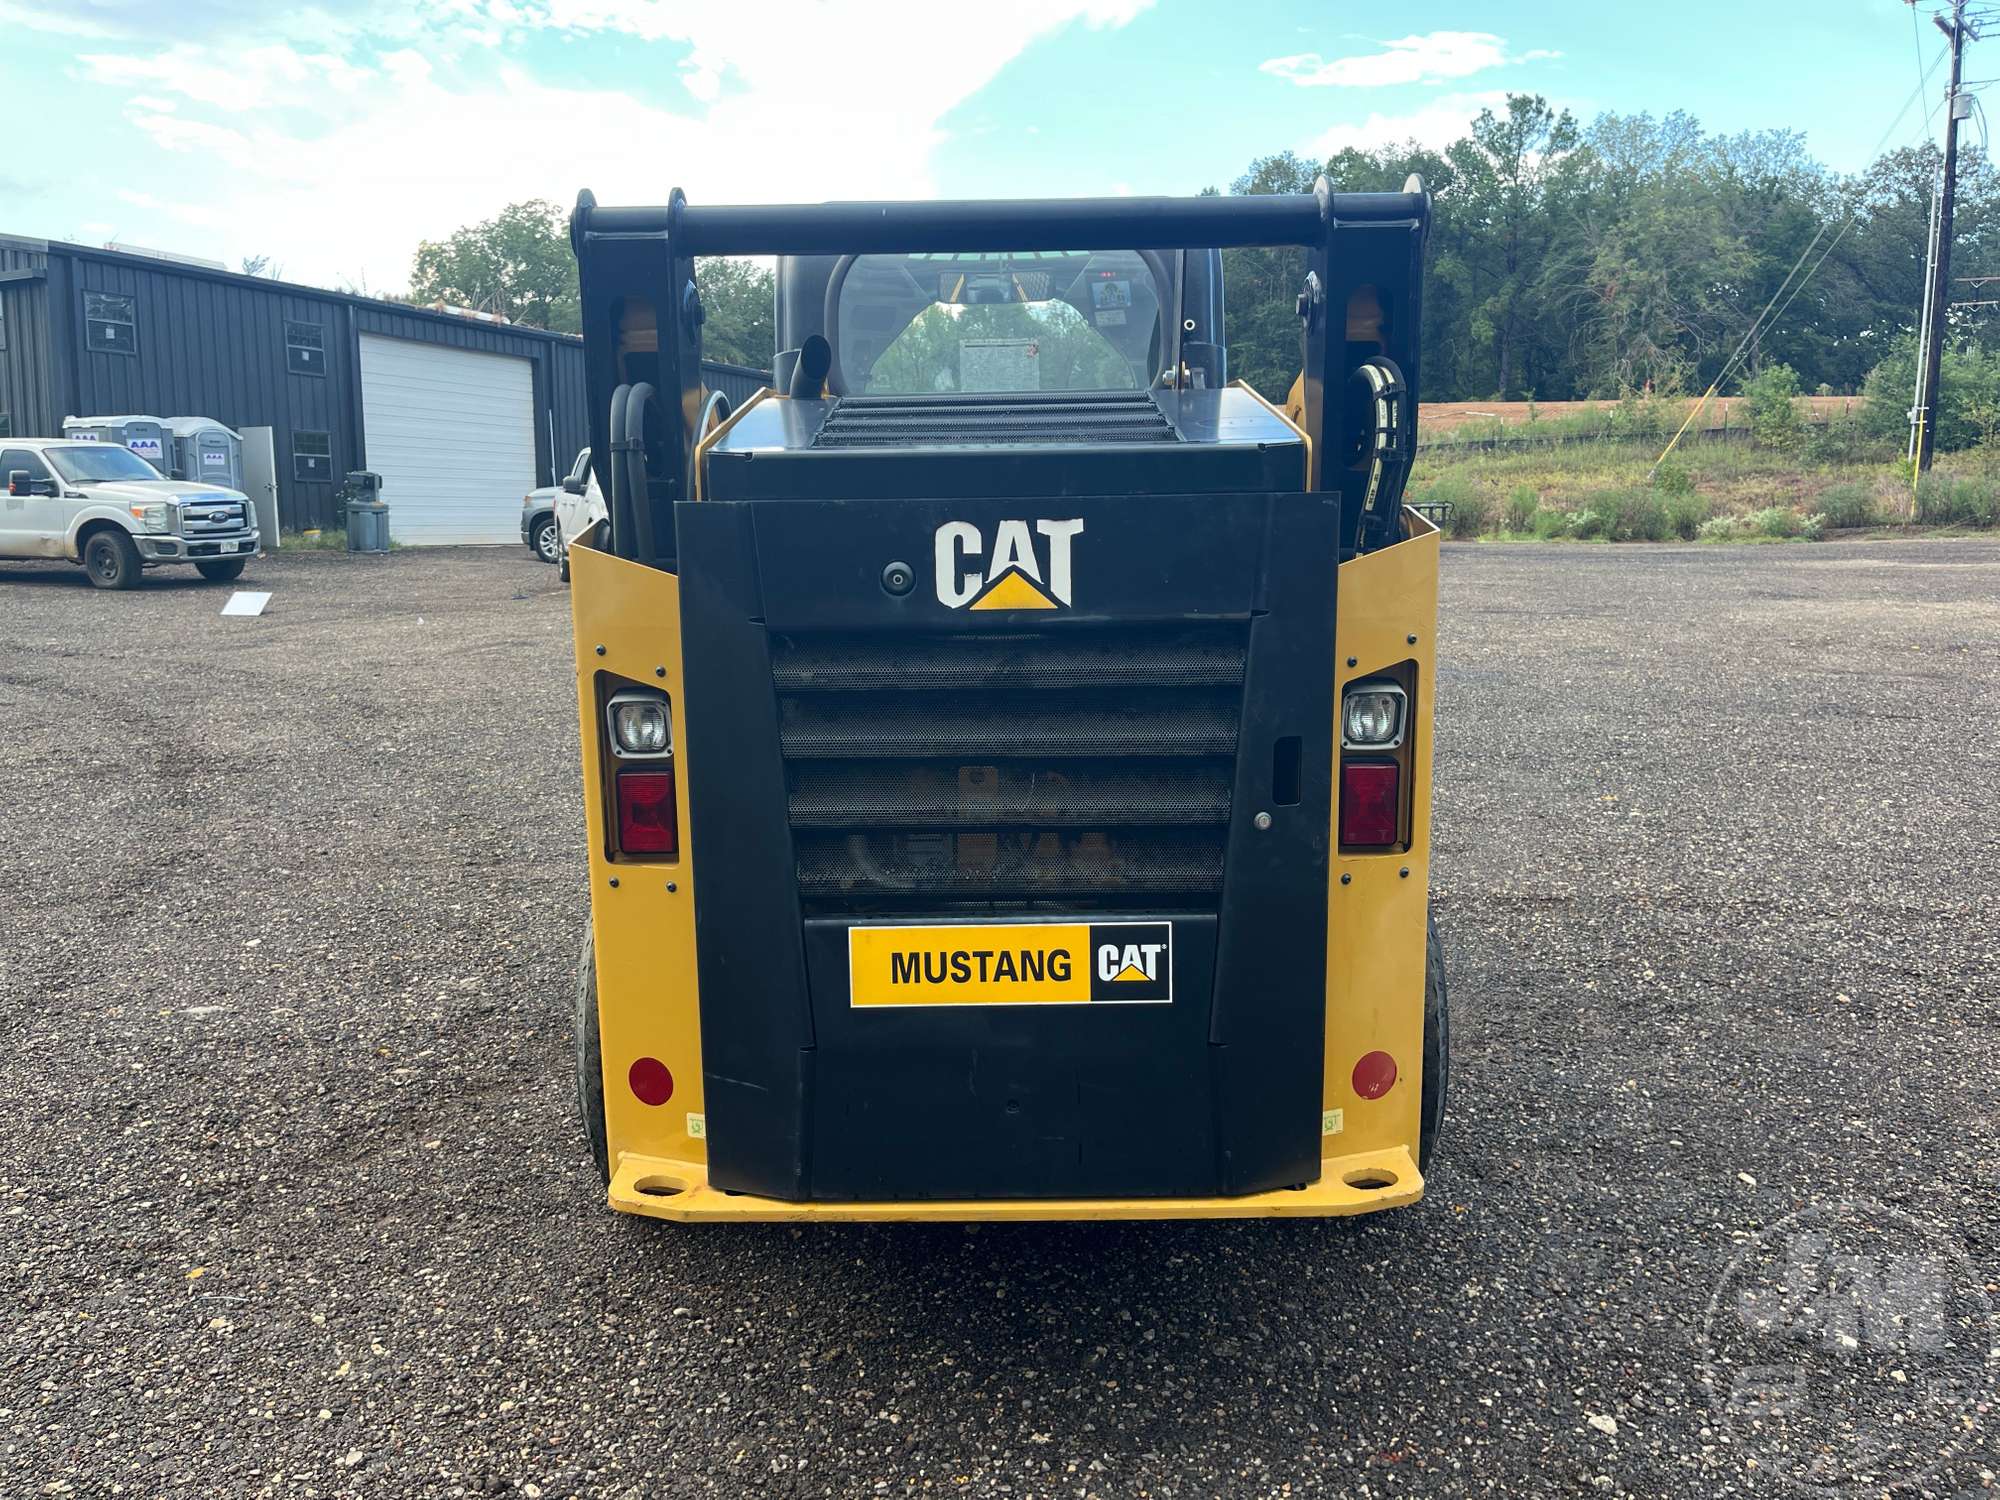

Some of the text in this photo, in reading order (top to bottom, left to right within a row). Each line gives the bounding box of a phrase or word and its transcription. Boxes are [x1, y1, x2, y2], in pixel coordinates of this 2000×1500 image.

[130, 440, 159, 449] AAA
[935, 518, 1084, 610] CAT
[890, 949, 1073, 984] MUSTANG
[1097, 943, 1162, 982] CAT
